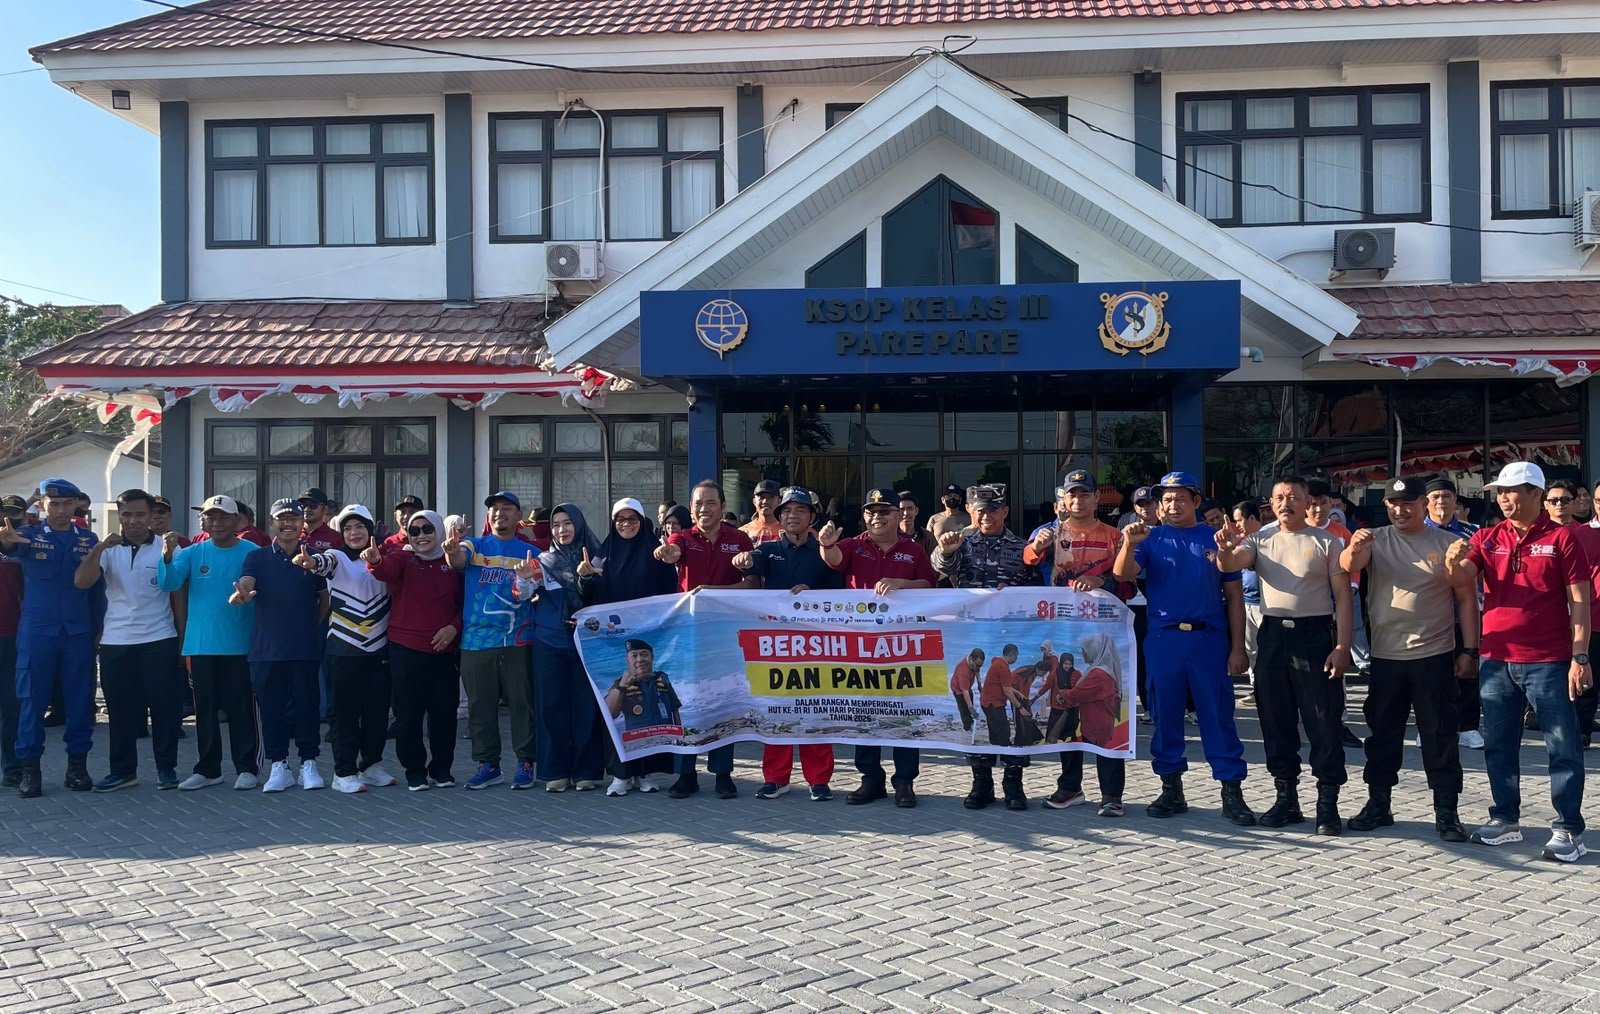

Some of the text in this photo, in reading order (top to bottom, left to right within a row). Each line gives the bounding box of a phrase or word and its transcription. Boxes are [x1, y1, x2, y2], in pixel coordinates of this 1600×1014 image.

[805, 295, 1049, 323] KSOP KELAS III
[758, 633, 925, 658] BERSIH LAUT
[769, 666, 923, 690] DAN PANTAI
[768, 706, 781, 714] HUT
[783, 706, 802, 714] KE-81
[848, 707, 899, 716] PERHUBUNGAN
[900, 708, 935, 717] NASIONAL
[795, 698, 904, 709] DALAM RANGKA MEMPERINGATI
[830, 714, 853, 722] TAHUN
